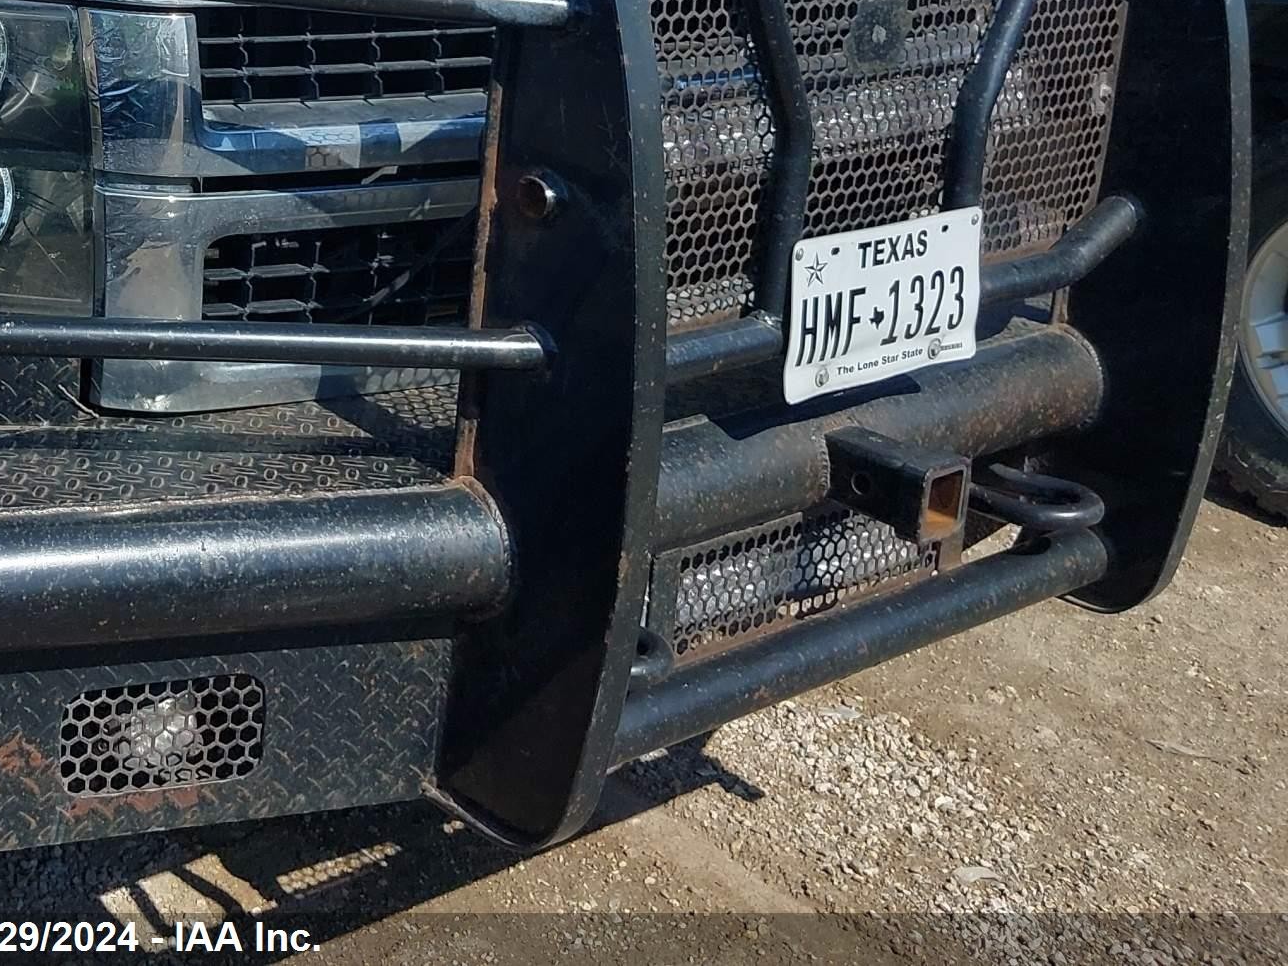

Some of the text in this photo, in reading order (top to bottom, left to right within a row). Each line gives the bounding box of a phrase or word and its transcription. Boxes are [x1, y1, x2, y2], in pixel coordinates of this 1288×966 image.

[857, 229, 928, 269] TEXAS
[795, 265, 965, 367] HMF 1323
[837, 347, 923, 375] The Lone Star State
